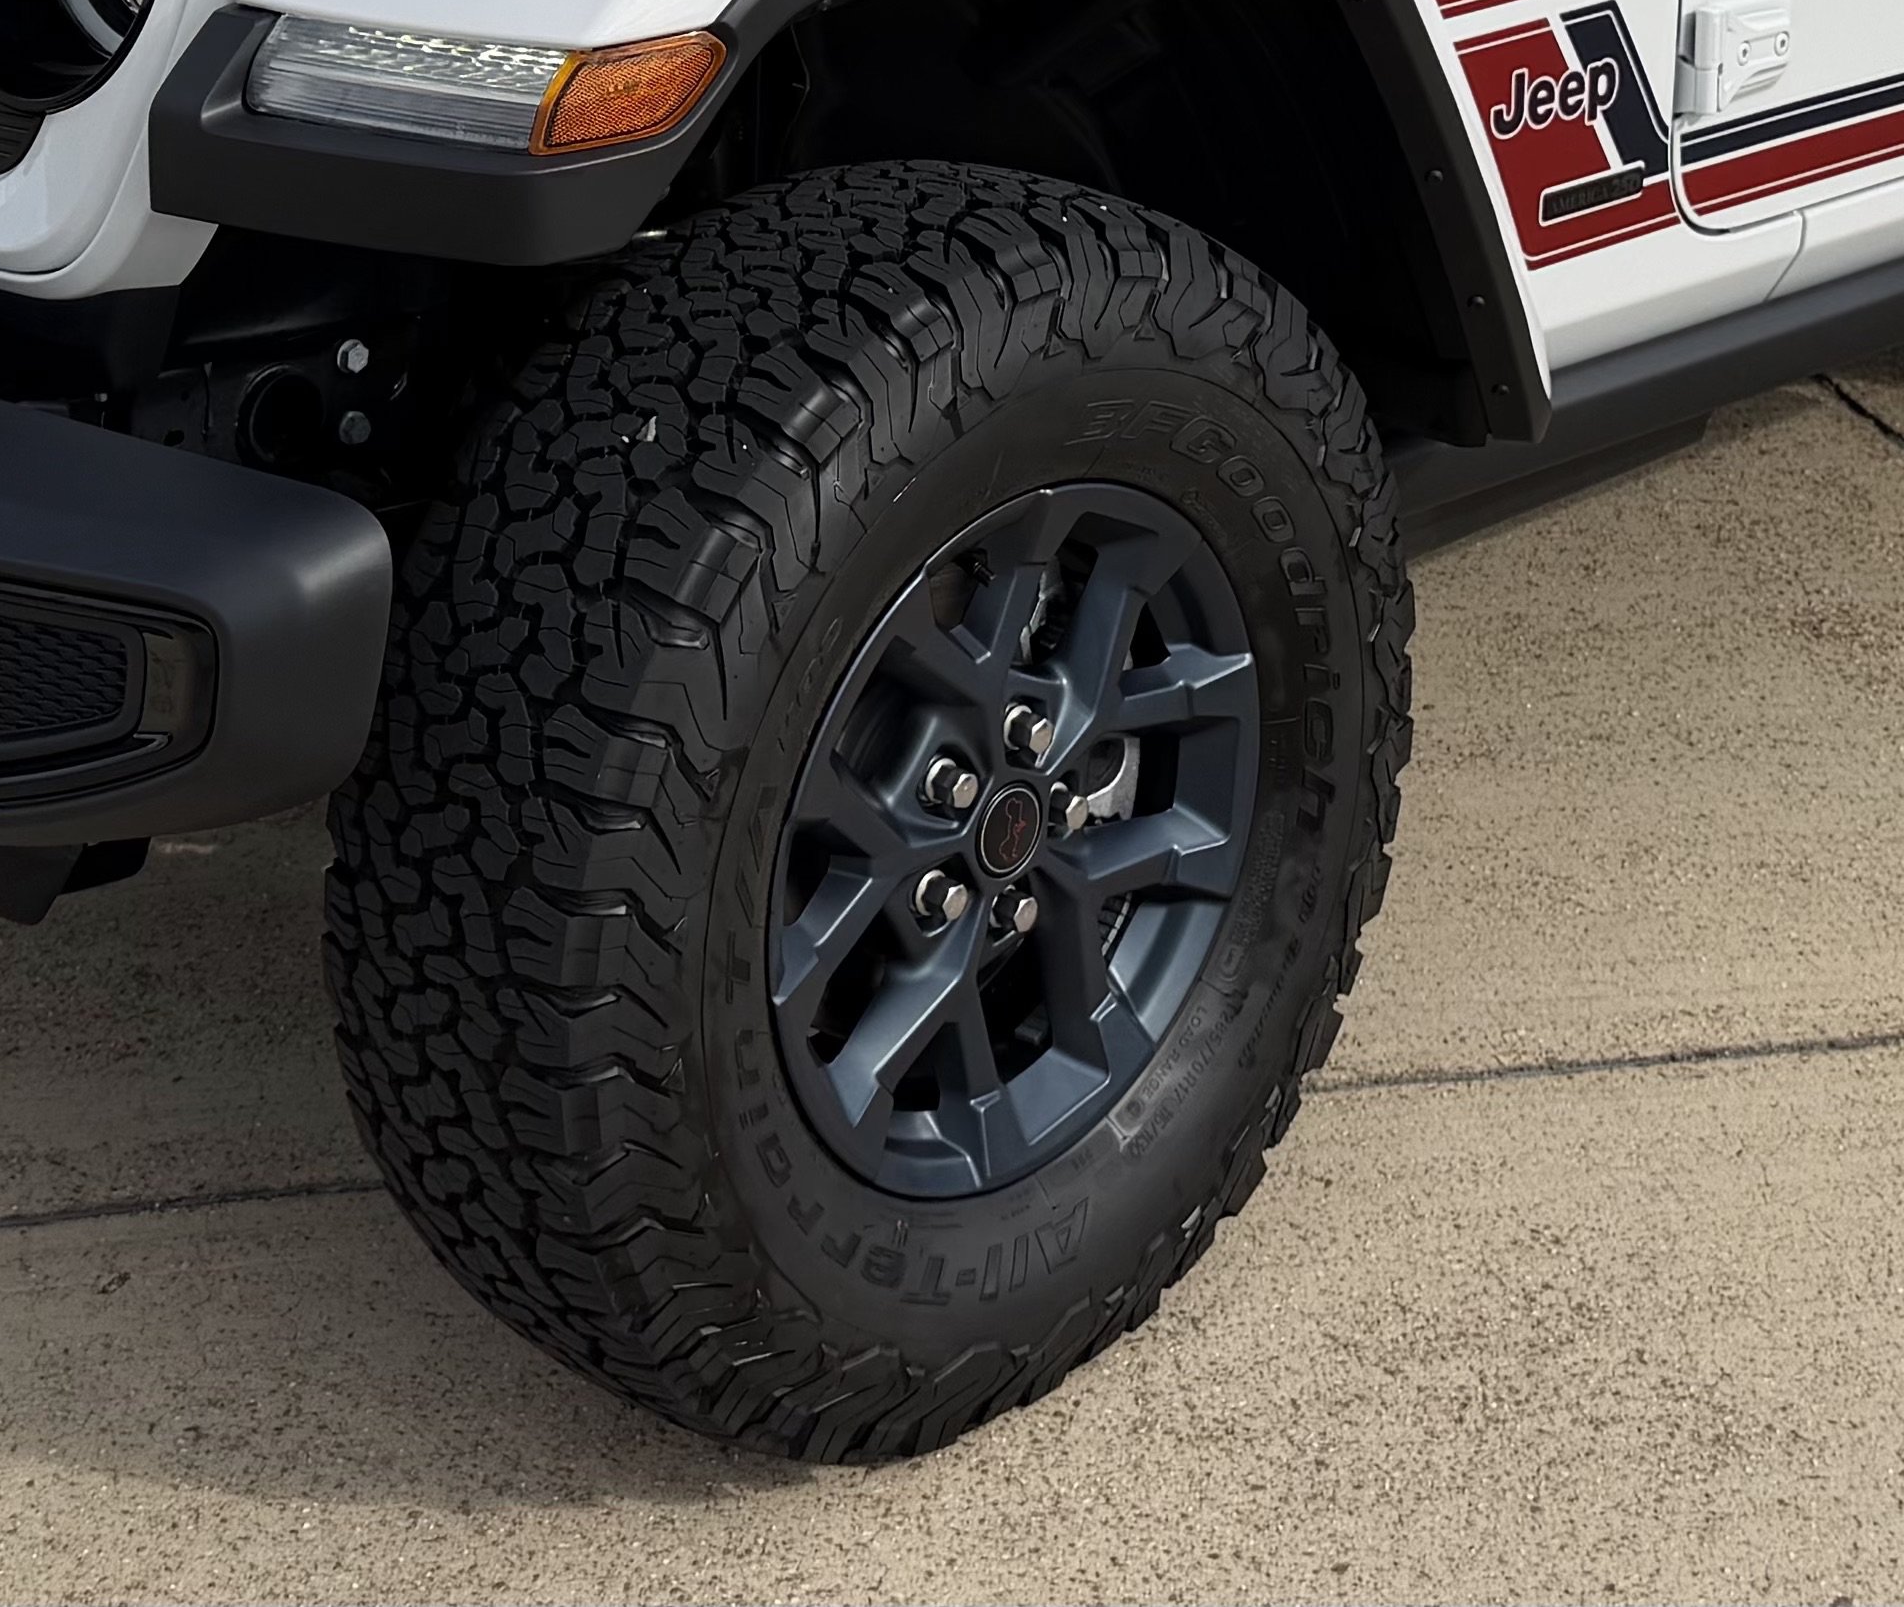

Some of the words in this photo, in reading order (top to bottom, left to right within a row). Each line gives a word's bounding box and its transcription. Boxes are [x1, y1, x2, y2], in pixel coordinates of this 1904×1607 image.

[1490, 57, 1619, 140] Jeep
[1063, 398, 1336, 832] BFGoodrich
[1179, 1005, 1208, 1048] LOAD
[735, 1028, 1089, 1306] All-Terrain
